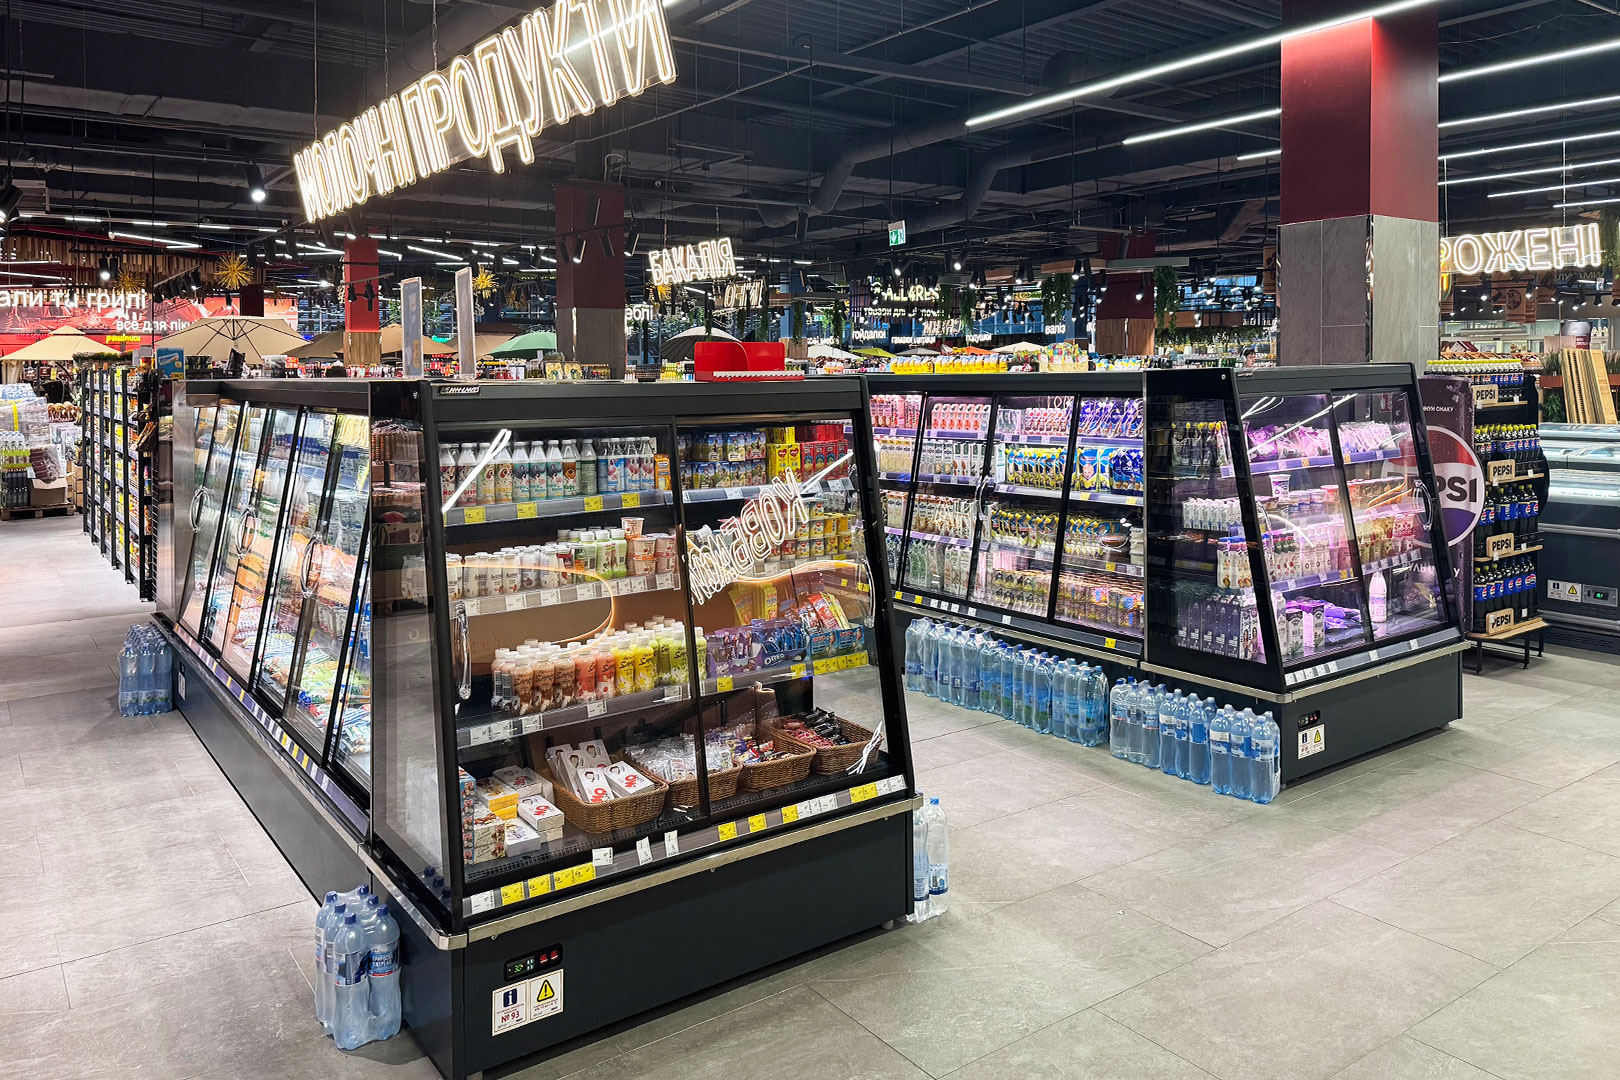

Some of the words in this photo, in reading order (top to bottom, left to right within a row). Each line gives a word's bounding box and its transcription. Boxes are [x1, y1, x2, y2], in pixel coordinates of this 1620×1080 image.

[1440, 222, 1603, 275] РОЖЕНІ
[649, 236, 736, 286] БАКАЛІЯ
[0, 288, 44, 308] али
[87, 287, 146, 313] грилі
[625, 304, 654, 321] еблі
[116, 320, 139, 331] все
[1476, 389, 1496, 400] PEPSI
[1493, 465, 1512, 476] PEPSI
[1492, 539, 1511, 551] PEPSI
[764, 653, 784, 665] OREO
[501, 1014, 510, 1023] №
[511, 1010, 520, 1020] 93
